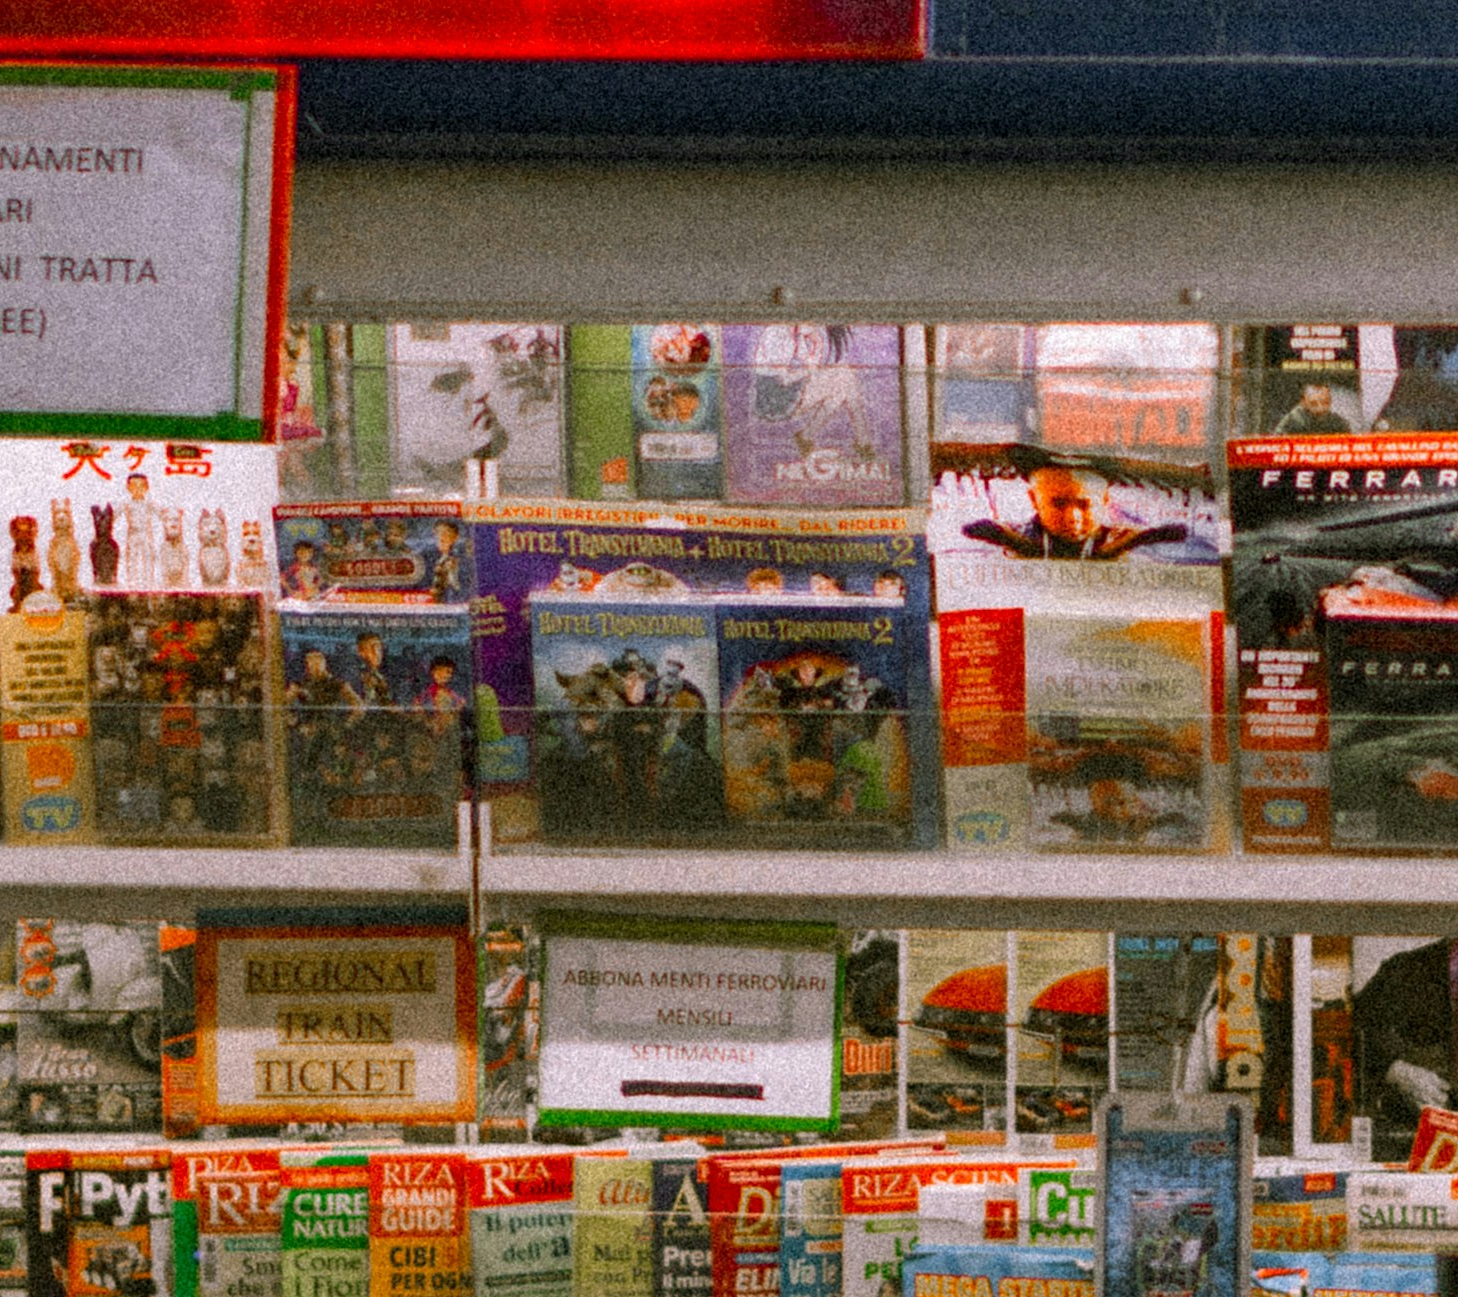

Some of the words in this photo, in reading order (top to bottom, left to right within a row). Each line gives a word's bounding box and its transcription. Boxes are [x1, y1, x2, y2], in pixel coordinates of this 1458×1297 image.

[42, 256, 158, 285] TRATTA
[245, 957, 437, 995] REGIONAL
[716, 972, 828, 992] FERROVIARI
[277, 1011, 392, 1043] TRAIN
[259, 1058, 415, 1096] TICKET
[382, 1162, 455, 1187] RIZA
[850, 1175, 918, 1202] RIZA
[380, 1210, 457, 1234] GUIDE
[1358, 1202, 1443, 1230] SALUTE
